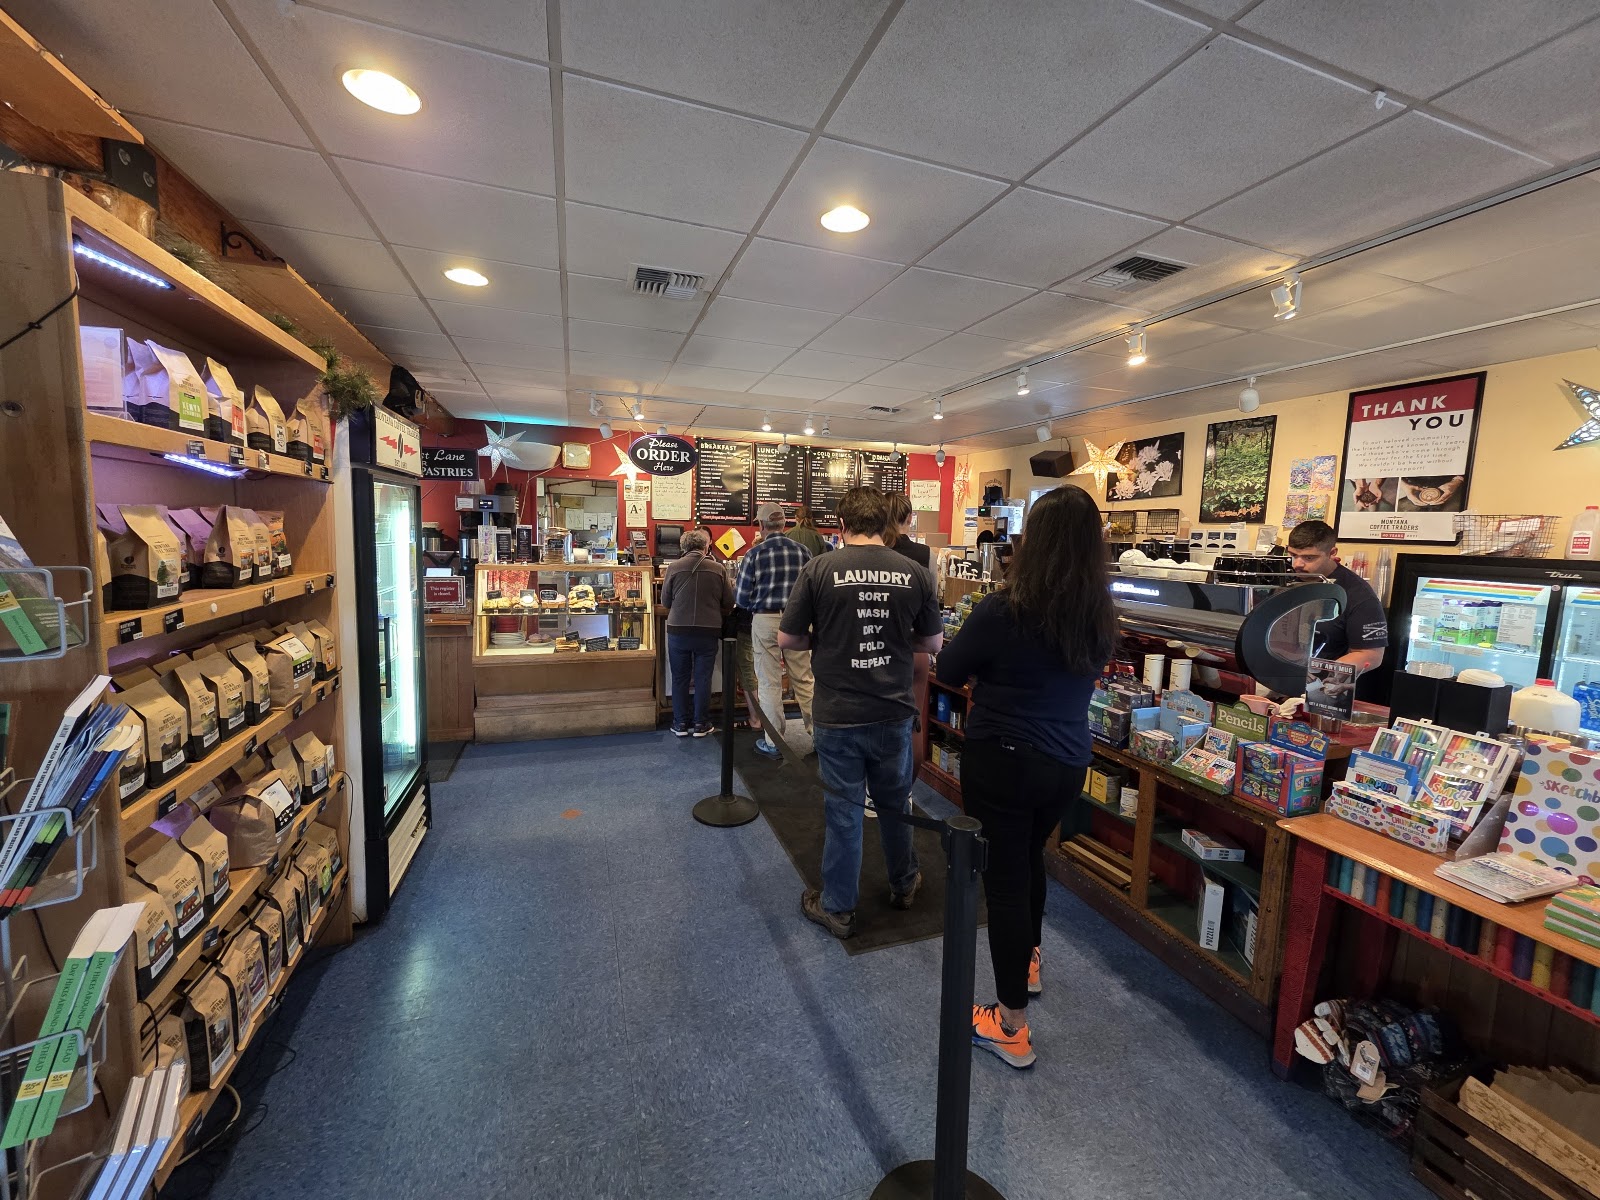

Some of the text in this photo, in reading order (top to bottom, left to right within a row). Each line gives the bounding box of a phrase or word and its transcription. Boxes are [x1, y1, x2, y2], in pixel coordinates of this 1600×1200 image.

[182, 400, 201, 413] KENYA
[1361, 395, 1447, 418] THANK
[1409, 413, 1464, 431] YOU
[649, 438, 679, 449] Please
[700, 442, 737, 451] BREAKFAST
[434, 449, 466, 461] Lane
[636, 448, 691, 463] ORDER
[757, 447, 780, 455] LUNCH
[422, 467, 474, 477] PASTRIES
[653, 461, 674, 471] Here
[630, 504, 643, 514] A+
[833, 569, 912, 585] LAUNDRY
[1545, 571, 1583, 580] True
[858, 591, 890, 602] SORT
[856, 608, 890, 619] WASH
[862, 624, 883, 636] DRY
[859, 641, 885, 653] FOLD
[851, 655, 892, 669] REPEAT
[1311, 660, 1353, 674] BUY ANY MUG
[1218, 708, 1265, 734] Pencils
[49, 750, 58, 760] OLD
[1206, 926, 1215, 947] PUZZLE
[68, 963, 80, 976] DAY
[95, 956, 106, 970] DAY
[63, 976, 75, 997] HIKES
[89, 971, 101, 992] HIKES
[80, 990, 93, 1020] AROUND
[53, 997, 67, 1032] AROUND
[62, 1028, 78, 1064] ATHEAD
